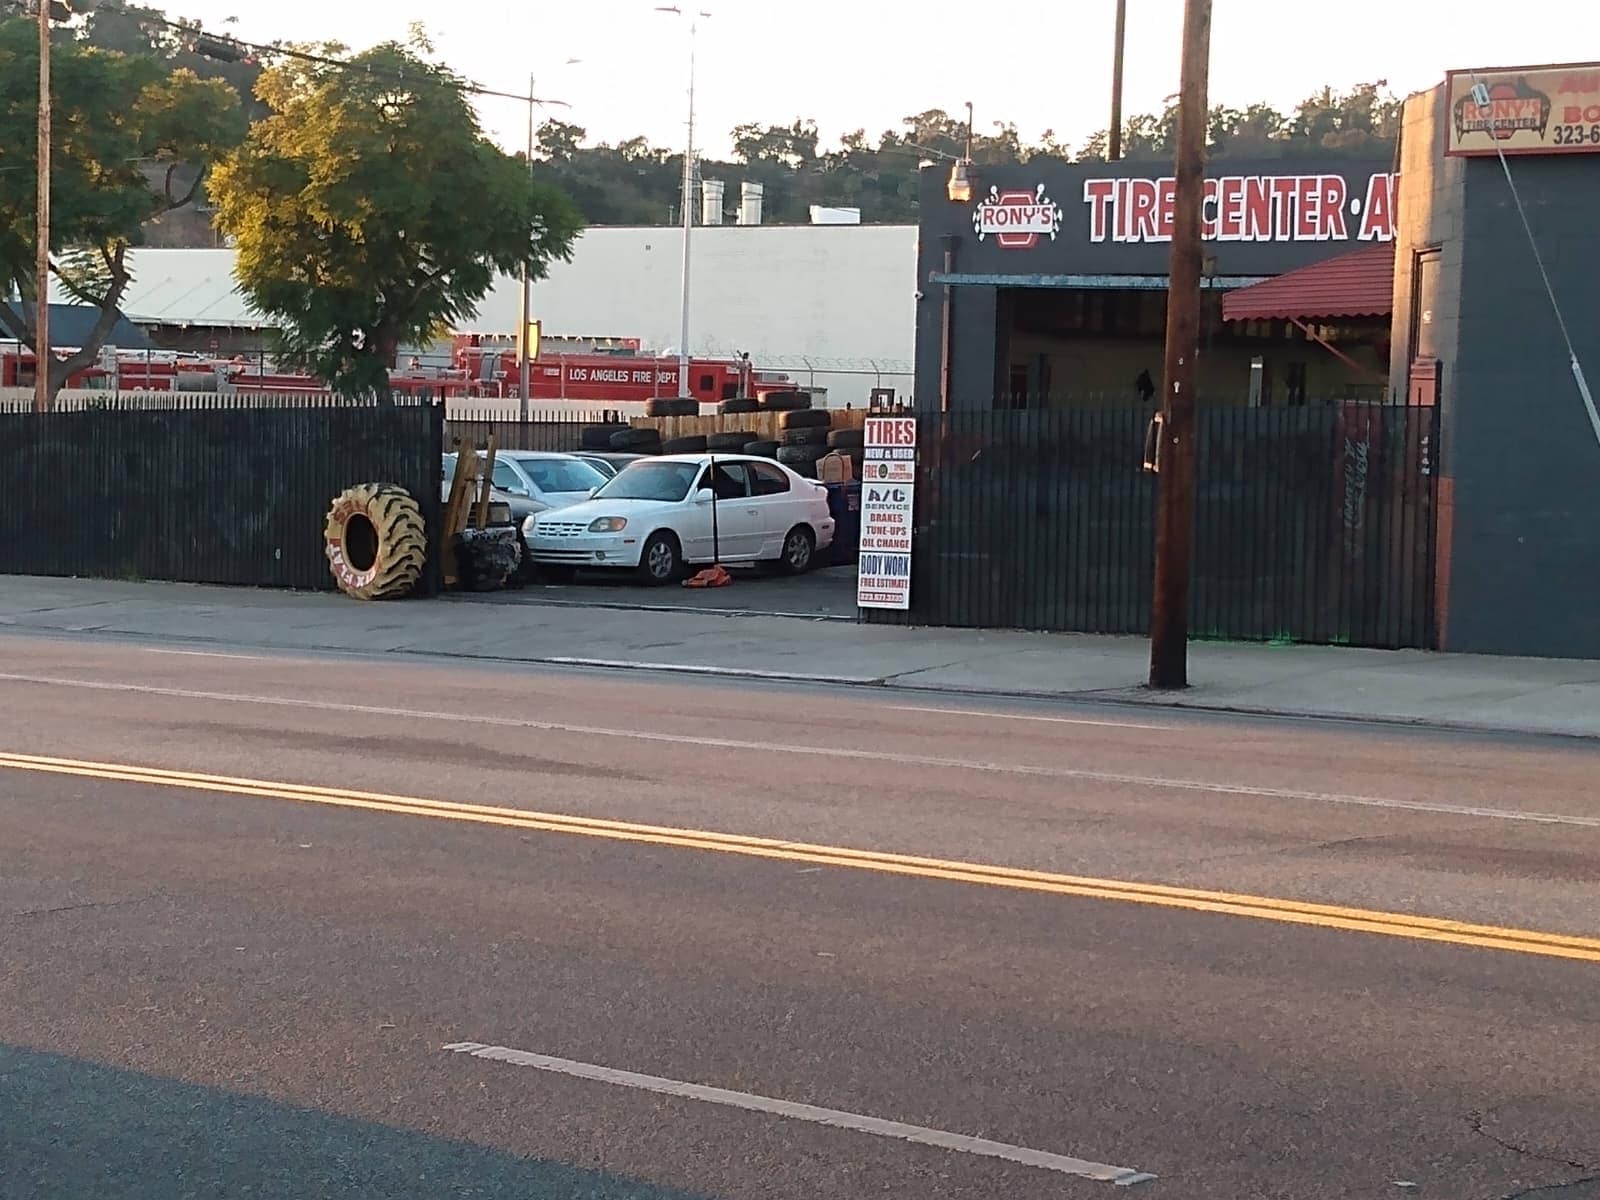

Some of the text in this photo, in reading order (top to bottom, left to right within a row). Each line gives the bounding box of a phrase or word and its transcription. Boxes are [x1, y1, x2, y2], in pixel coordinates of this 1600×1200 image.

[1564, 105, 1600, 124] BO
[1466, 117, 1537, 130] TIRE CENTER
[1553, 124, 1600, 144] 323-6
[982, 205, 1053, 228] RONY'S
[1084, 177, 1176, 243] TIRE
[569, 368, 587, 381] LOS
[590, 369, 628, 382] ANGELES
[632, 371, 651, 383] FIRE
[867, 420, 914, 445] TIRES
[892, 448, 914, 459] USED
[864, 464, 878, 479] FREE
[868, 488, 905, 503] A/C
[865, 503, 910, 511] SERVICE
[870, 513, 903, 523] BRAKES
[866, 525, 907, 536] TUNE-UPS
[862, 538, 909, 549] OIL CHANGE
[860, 554, 909, 577] BODY WORK
[860, 577, 908, 589] FREE ESTIMATE
